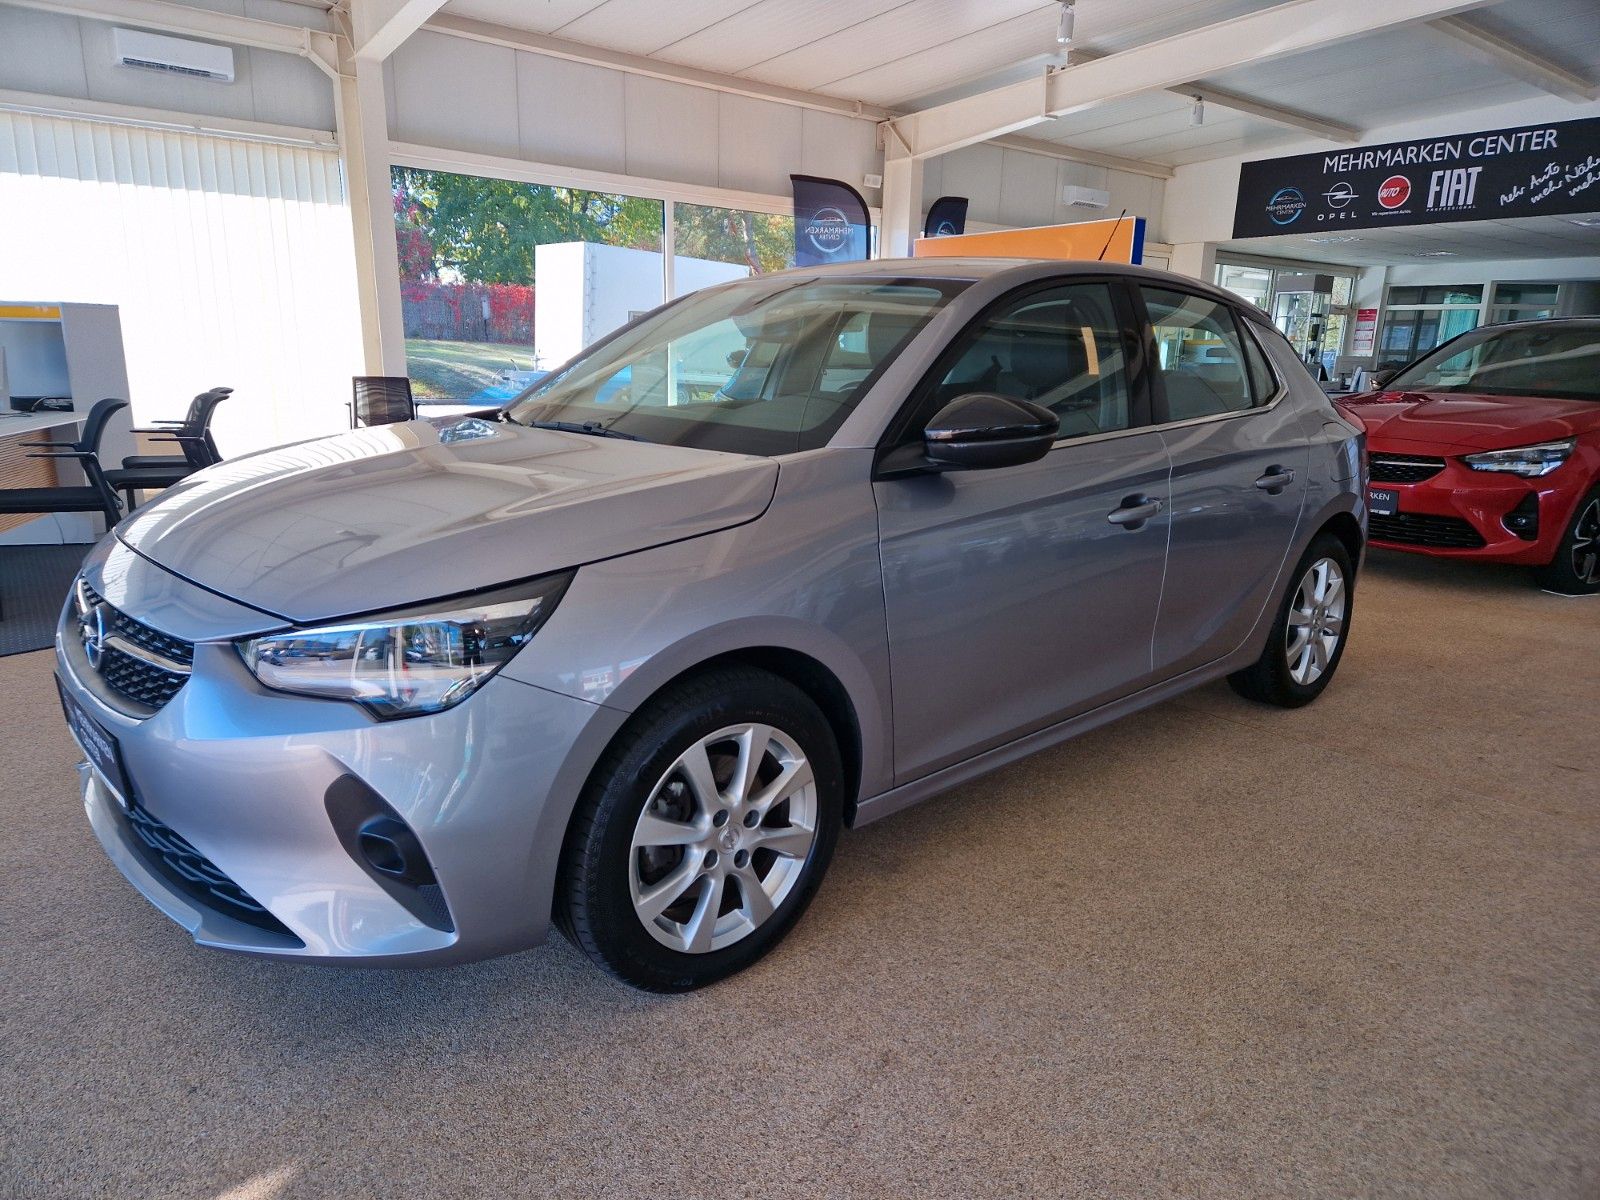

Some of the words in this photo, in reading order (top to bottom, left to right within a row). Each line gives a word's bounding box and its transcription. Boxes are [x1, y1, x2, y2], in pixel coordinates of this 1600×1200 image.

[1323, 140, 1462, 174] MEHRMARKEN
[1468, 129, 1557, 157] CENTER
[1427, 166, 1483, 208] FIAT
[1530, 162, 1560, 189] Auto
[1531, 180, 1563, 203] mehr
[1265, 202, 1307, 212] MEHRMARKEN
[1317, 211, 1357, 221] OPEL
